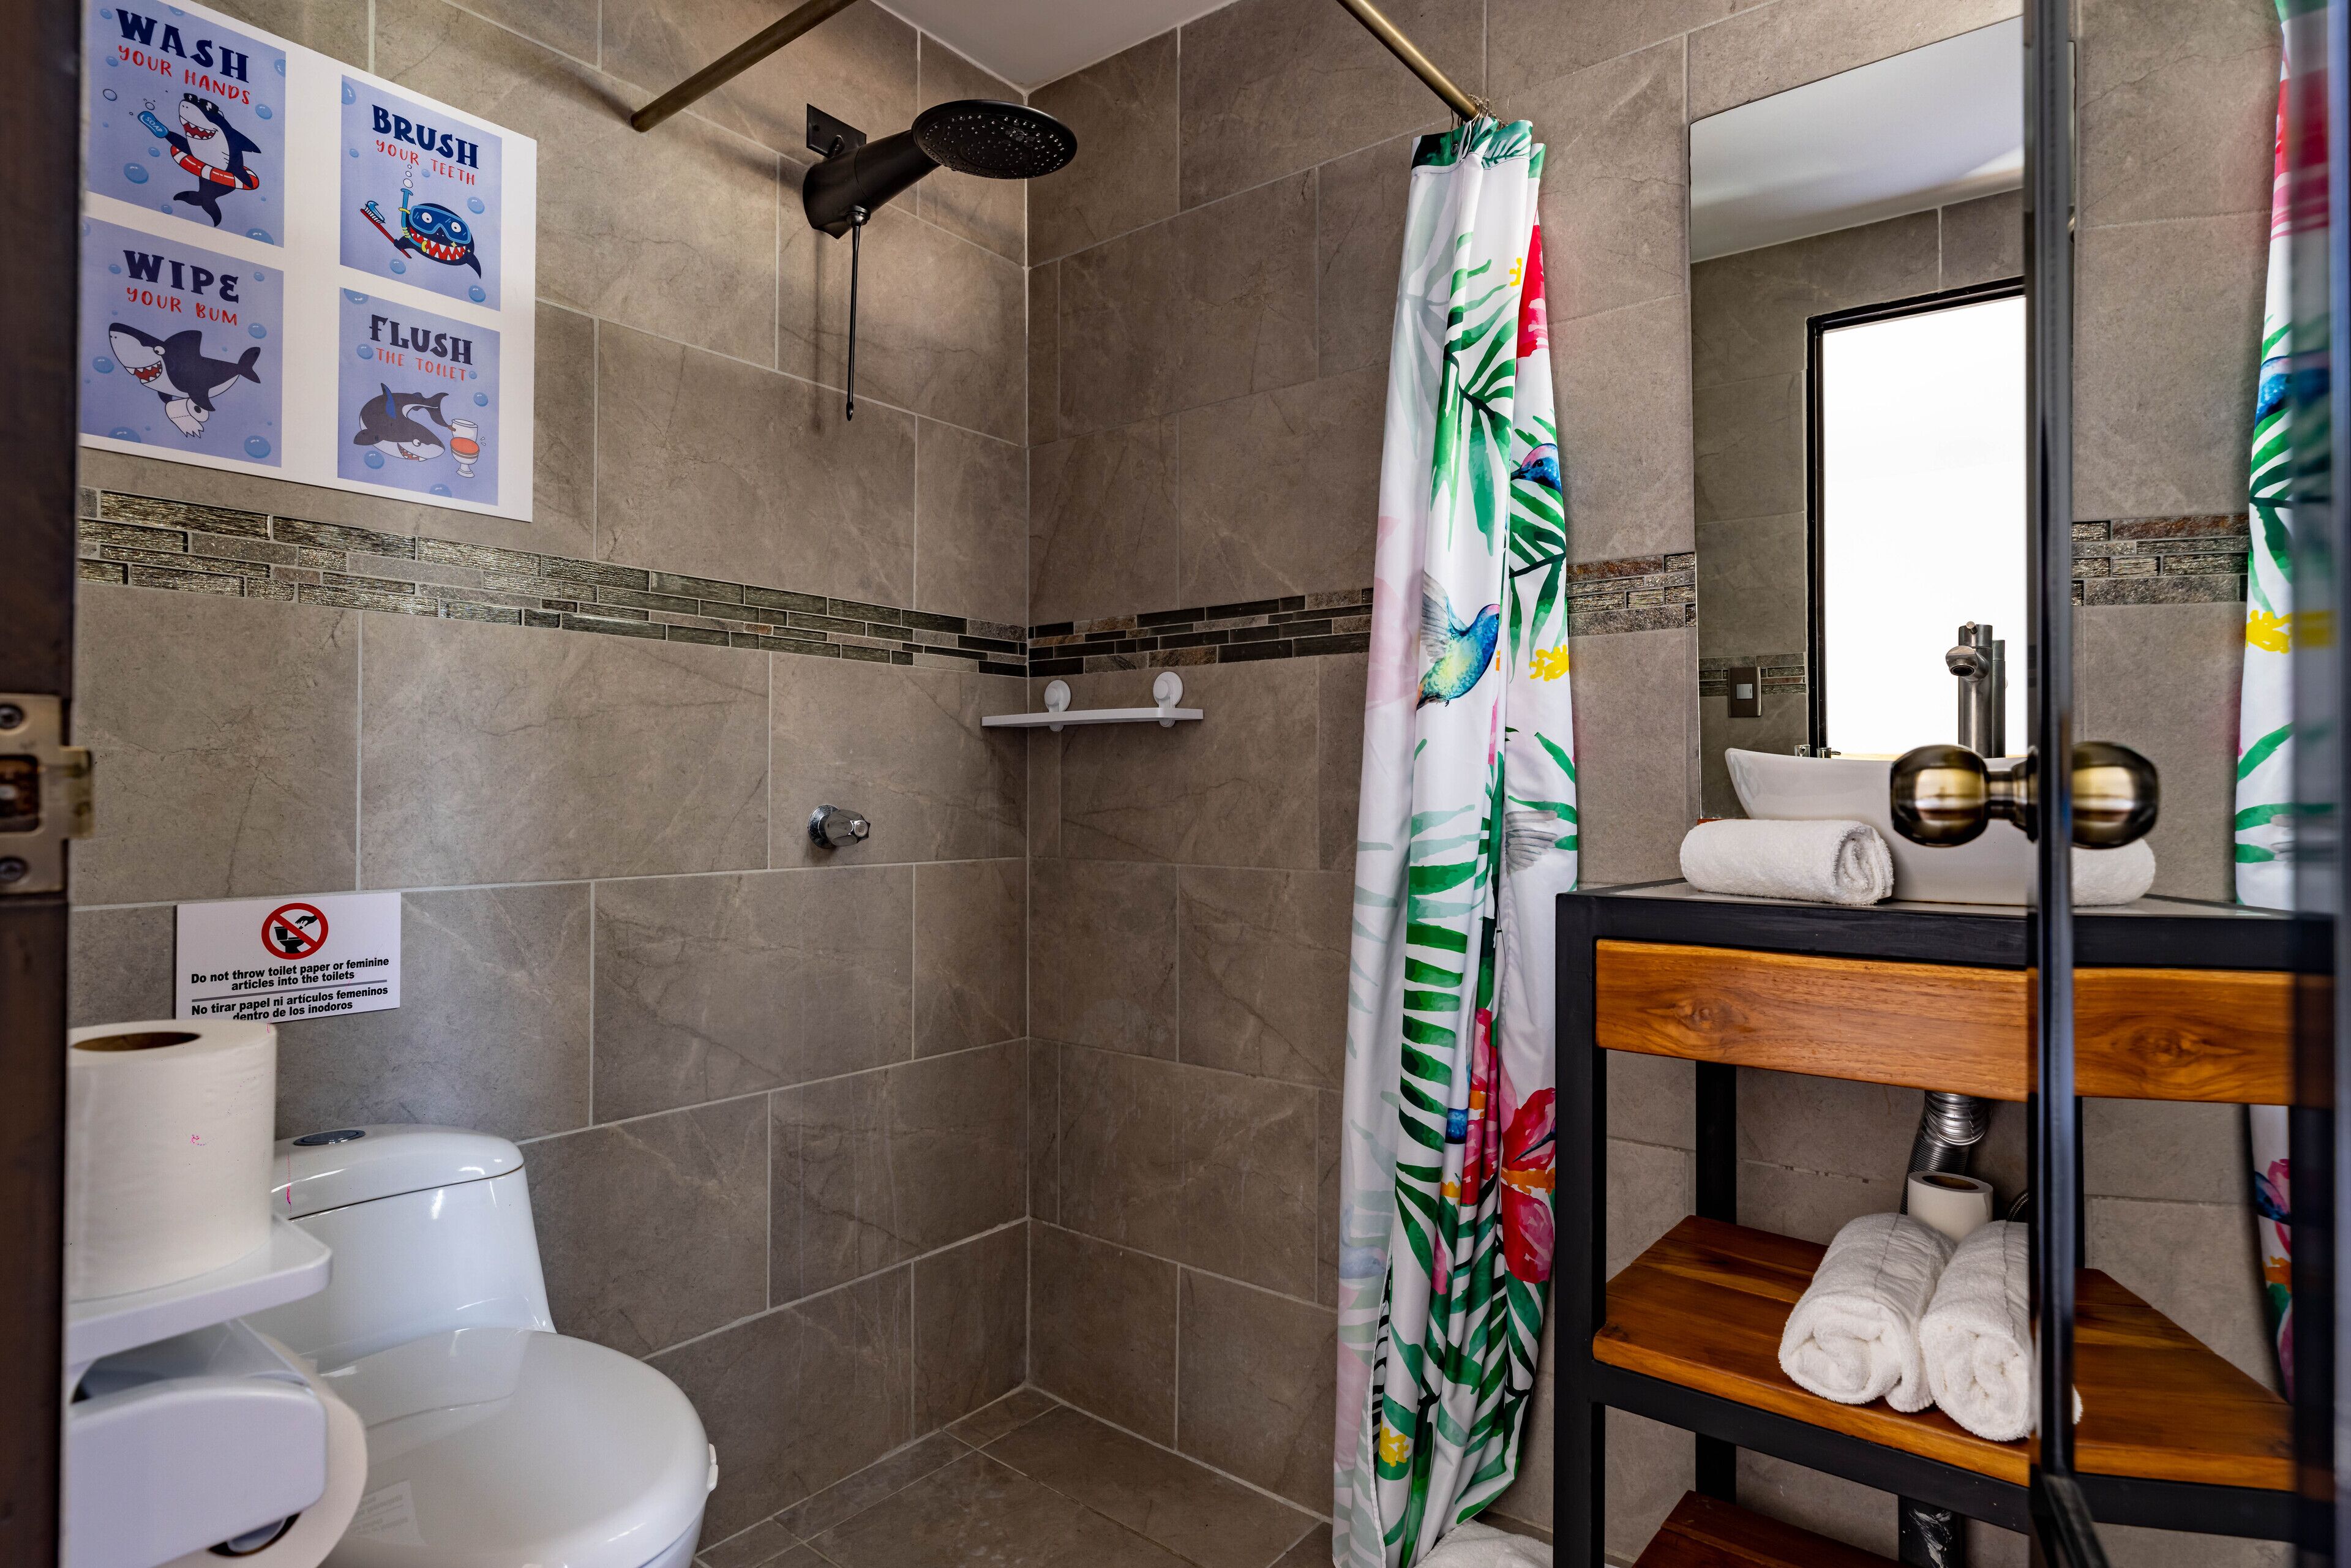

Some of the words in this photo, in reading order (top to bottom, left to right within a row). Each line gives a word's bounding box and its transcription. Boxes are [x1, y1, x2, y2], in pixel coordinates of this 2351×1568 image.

[116, 9, 249, 83] WASH
[118, 45, 172, 77] YOUR
[185, 69, 250, 104] HANDS
[145, 116, 163, 132] SOAP
[372, 104, 479, 170] BRUSH
[376, 140, 419, 166] YOUR
[430, 158, 475, 186] TEETH
[122, 250, 239, 304] WIPE
[126, 287, 182, 313] YOUR
[195, 302, 237, 326] BUM
[369, 314, 473, 366] FLUSH
[376, 348, 405, 367] THE
[415, 358, 467, 381] TOILET
[191, 973, 207, 984] Do
[210, 971, 229, 982] not
[232, 970, 265, 980] throw
[268, 965, 297, 977] toilet
[300, 964, 330, 975] paper
[347, 958, 389, 969] feminine
[231, 978, 274, 991] articles
[277, 975, 299, 986] into
[302, 973, 319, 983] the
[322, 970, 354, 981] toilets
[192, 1005, 208, 1015] No
[211, 1003, 236, 1013] tirar
[239, 997, 270, 1013] papel
[273, 996, 283, 1006] ni
[287, 992, 334, 1005] artículos
[336, 987, 388, 999] femeninos
[233, 1012, 269, 1021] dentro
[272, 1008, 287, 1018] de
[289, 1006, 305, 1016] los
[308, 1001, 353, 1014] inodoros
